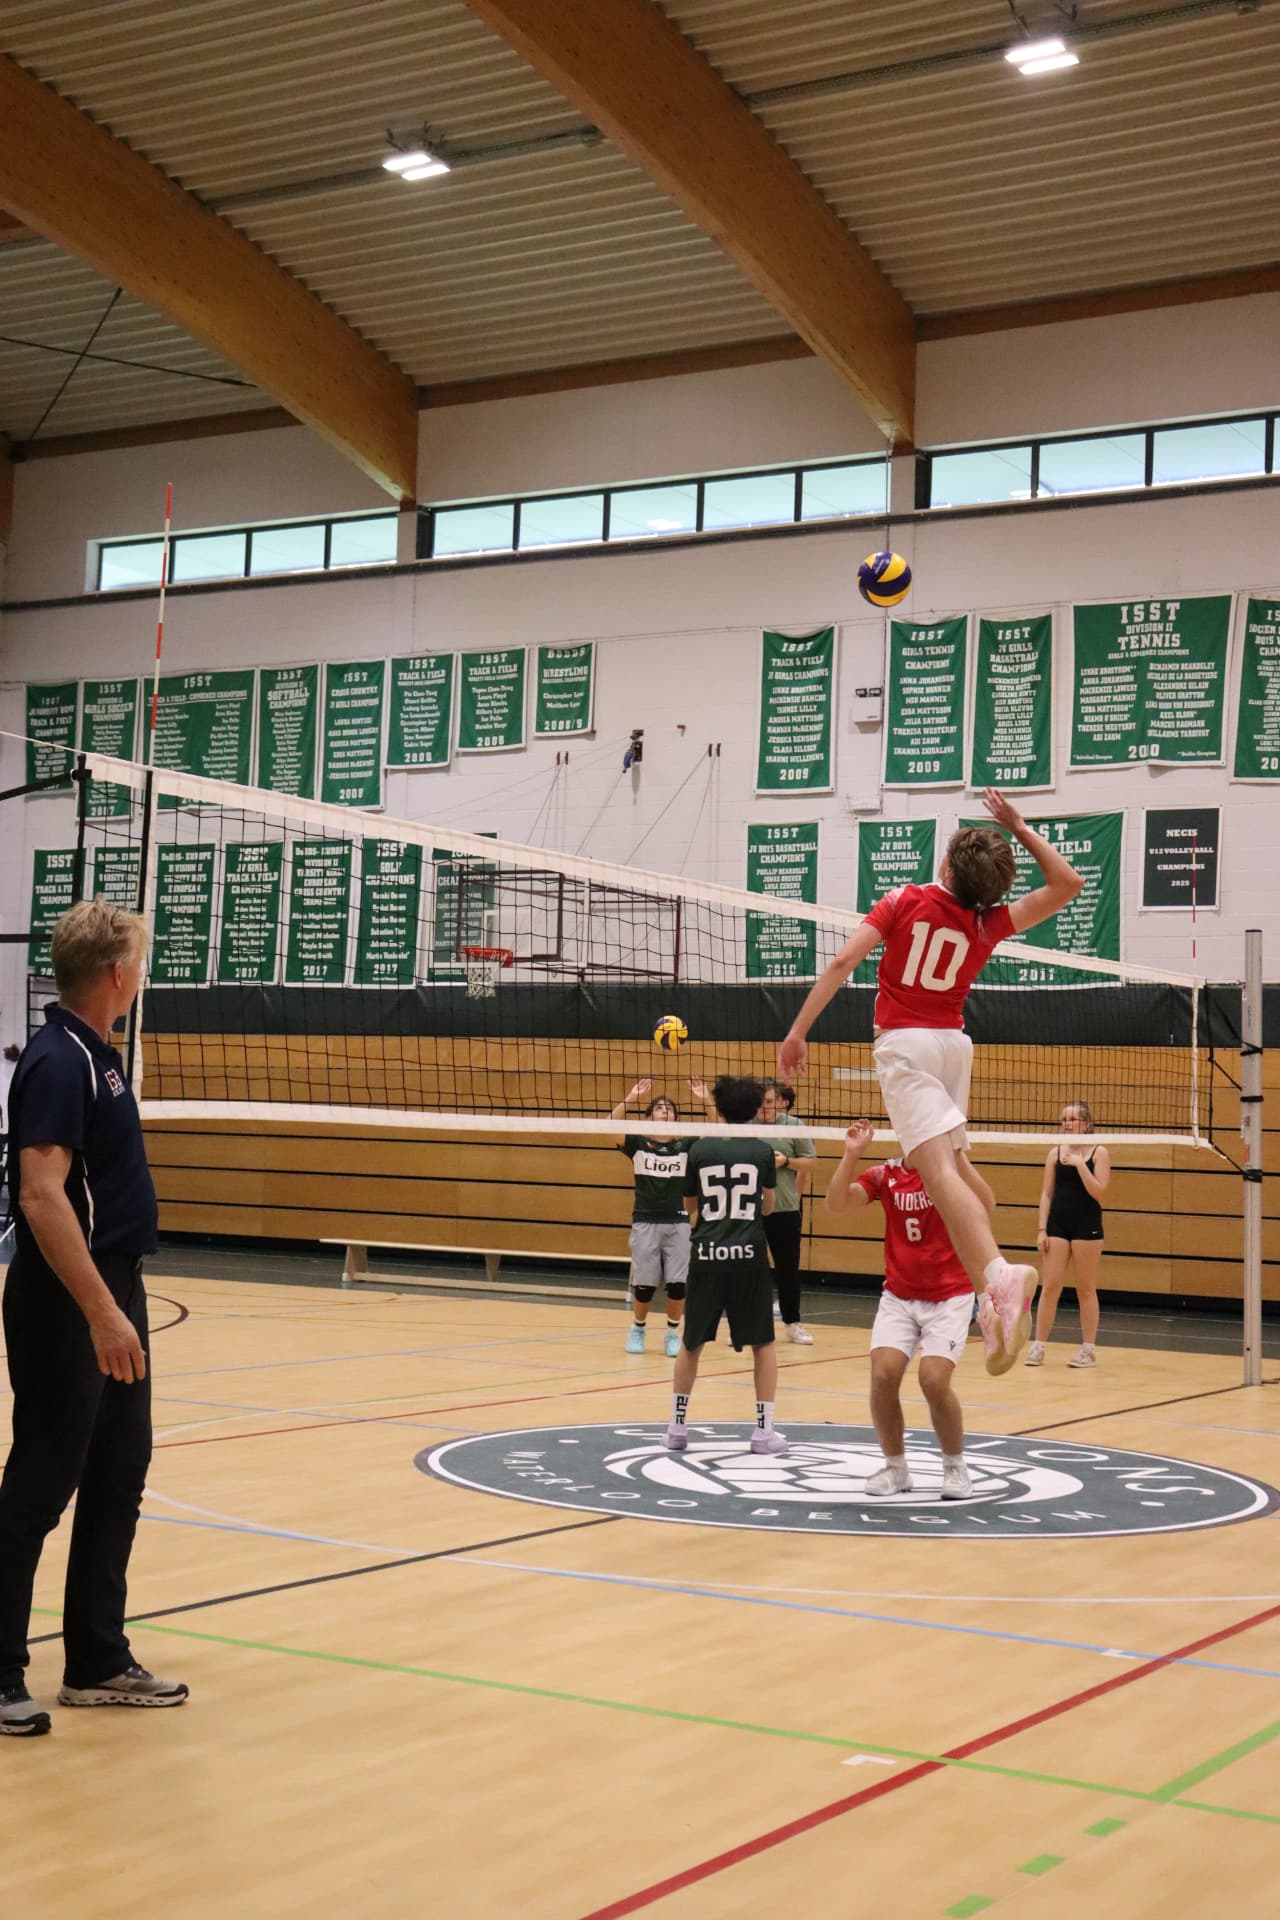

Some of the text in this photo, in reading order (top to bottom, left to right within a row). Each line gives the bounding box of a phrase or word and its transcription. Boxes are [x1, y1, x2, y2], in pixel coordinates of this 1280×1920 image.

[1121, 602, 1180, 624] ISST
[998, 627, 1030, 640] ISST
[1126, 623, 1164, 634] DIVISION
[911, 630, 944, 640] ISST
[781, 642, 814, 652] ISST
[1009, 642, 1032, 652] GIRLS
[1118, 633, 1180, 650] TENNIS
[902, 647, 923, 656] GIRLS
[409, 658, 436, 669] ISST
[480, 653, 508, 664] ISST
[905, 659, 949, 669] CHAMPIONS
[544, 666, 588, 677] WRESTLING
[992, 662, 1036, 673] CHAMPIONS
[277, 670, 302, 680] ISST
[344, 672, 368, 683] ISST
[184, 675, 212, 688] ISST
[99, 684, 123, 694] ISST
[267, 687, 310, 701] SOFTBALL
[908, 760, 940, 773] 2009
[779, 768, 808, 780] 2009
[995, 767, 1027, 780] 2009
[768, 828, 799, 839] ISST
[880, 826, 913, 837] ISST
[1166, 829, 1198, 837] NECIS
[377, 842, 407, 856] ISST
[776, 842, 817, 852] BASKETBALL
[881, 841, 912, 850] JV BOYS
[47, 854, 73, 868] ISST
[761, 854, 805, 864] CHAMPIONS
[871, 851, 922, 860] BASKETBALL
[873, 861, 918, 871] CHAMPIONS
[902, 921, 970, 992] 10
[235, 968, 258, 978] 2017
[303, 965, 328, 976] 2017
[374, 964, 398, 974] 2017
[644, 1158, 681, 1172] Lions
[699, 1164, 759, 1222] 52
[906, 1218, 922, 1242] 6
[698, 1242, 754, 1261] Lions
[503, 1450, 698, 1508] WATERLOO
[750, 1508, 1107, 1525] BELGIUM
